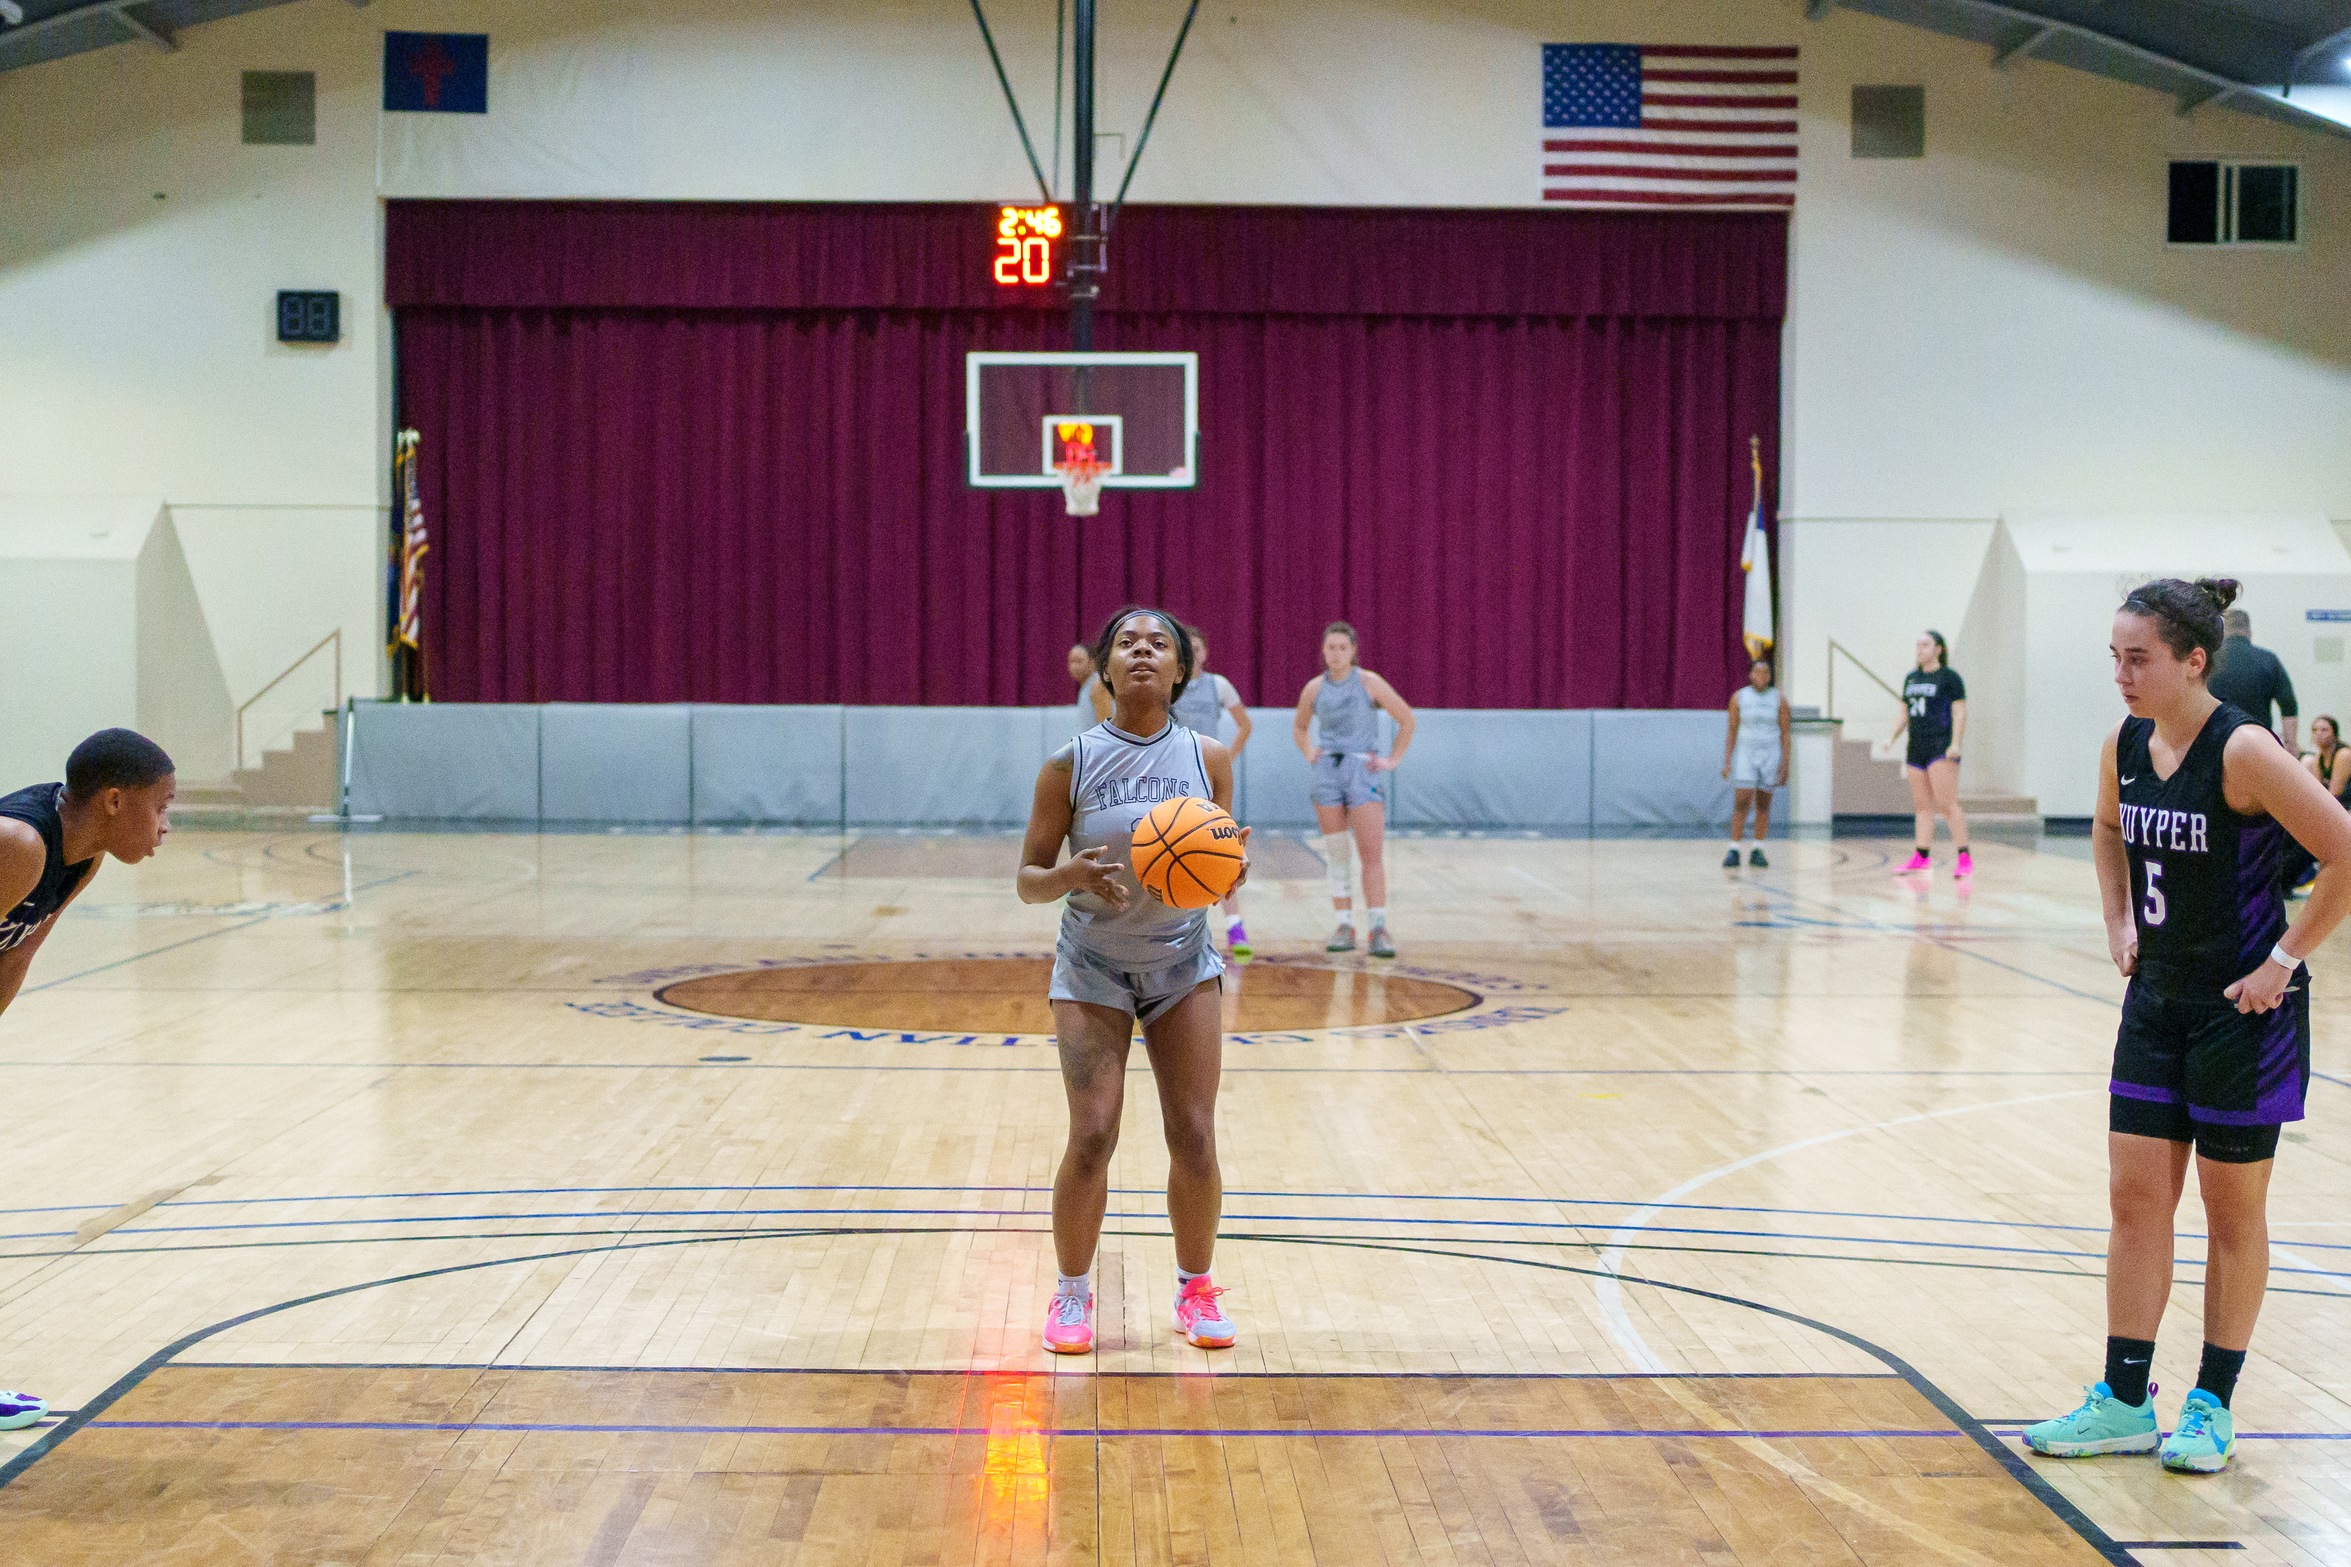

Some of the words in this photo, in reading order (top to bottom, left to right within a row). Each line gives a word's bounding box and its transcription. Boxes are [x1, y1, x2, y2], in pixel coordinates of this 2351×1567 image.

[999, 207, 1062, 238] 2:46
[995, 237, 1050, 284] 20
[1095, 776, 1190, 811] FALCONS
[2143, 860, 2166, 926] 5
